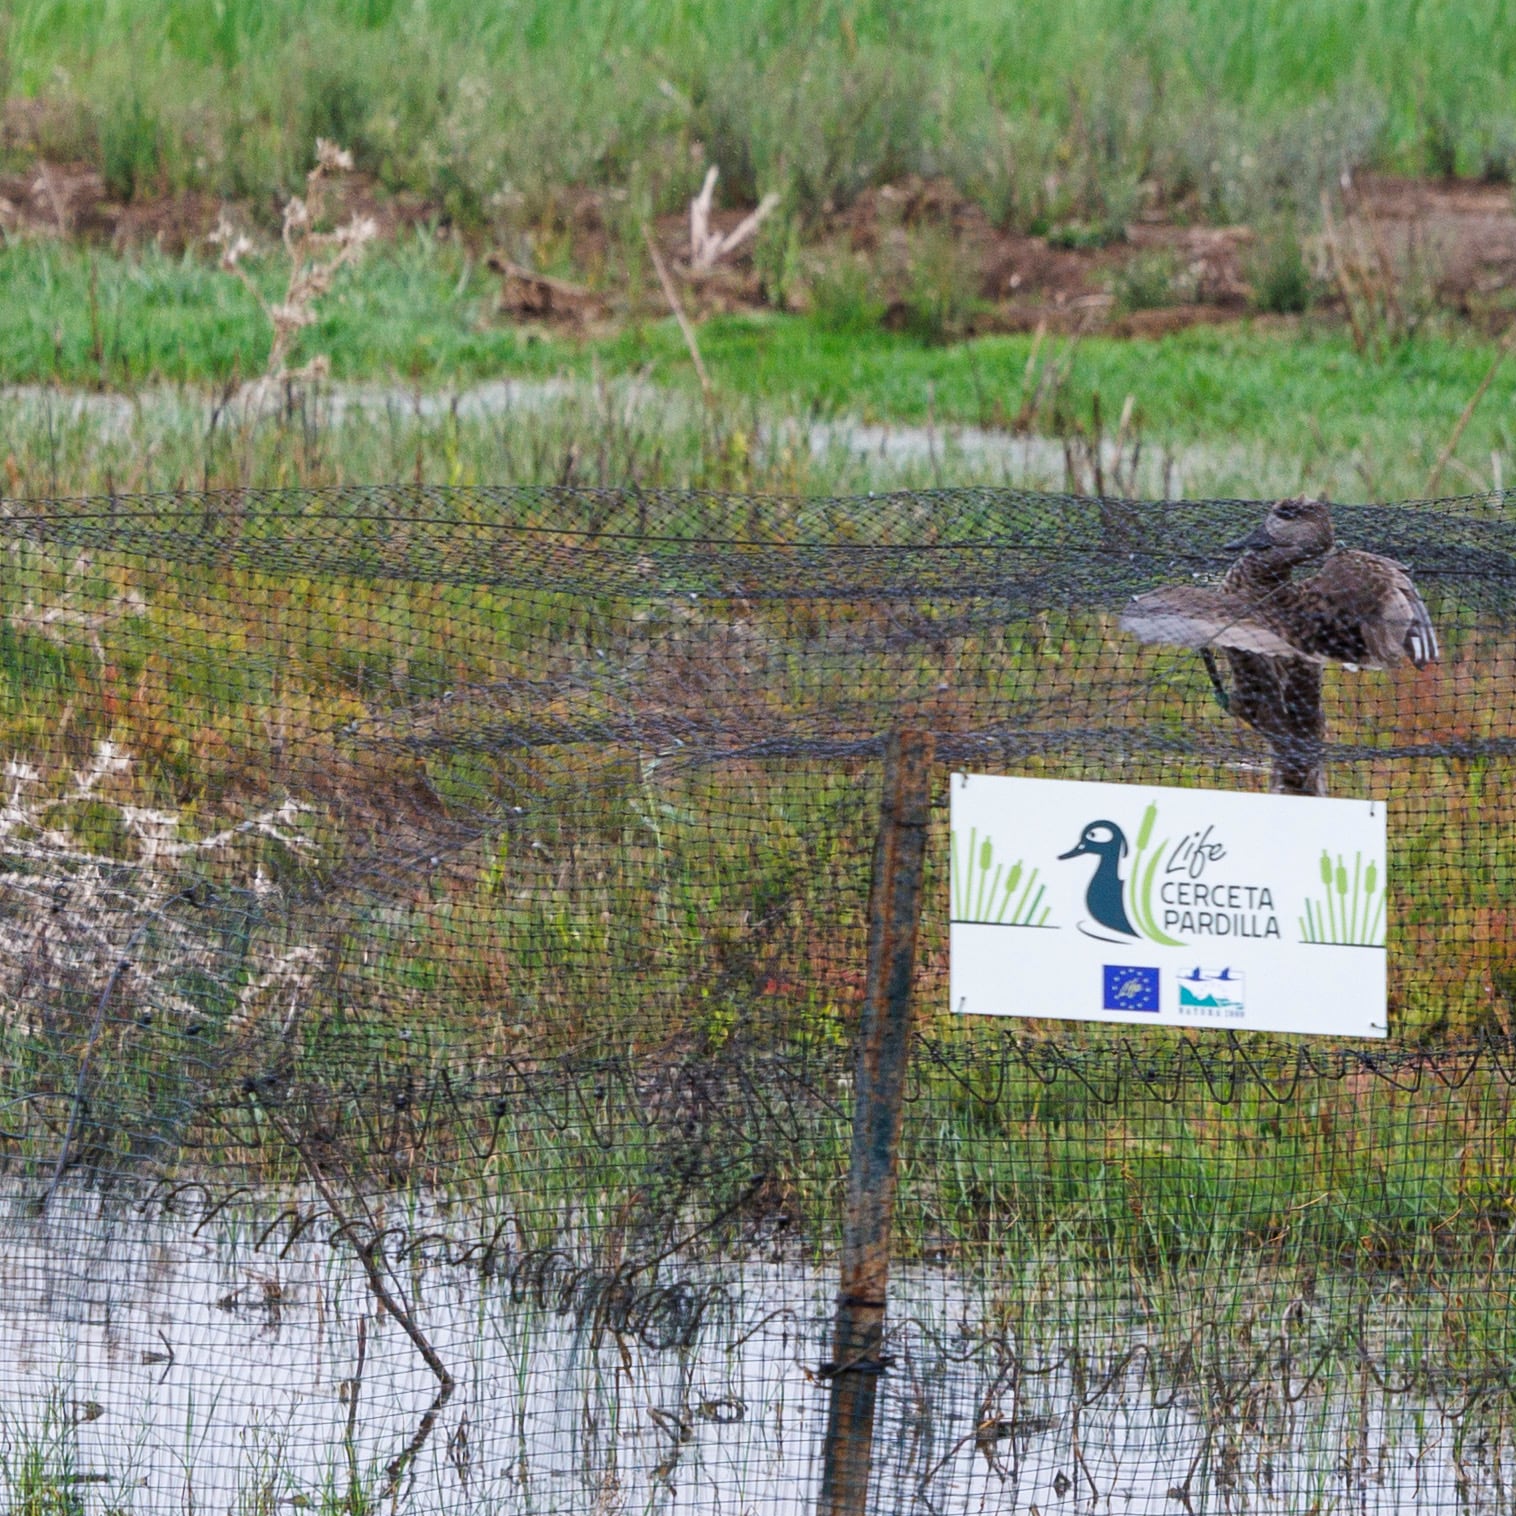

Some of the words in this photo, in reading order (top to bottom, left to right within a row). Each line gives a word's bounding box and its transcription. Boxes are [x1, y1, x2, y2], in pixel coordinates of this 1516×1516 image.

[1165, 824, 1227, 879] Life
[1160, 881, 1274, 910] CERCETA
[1164, 909, 1281, 939] PARDILLA
